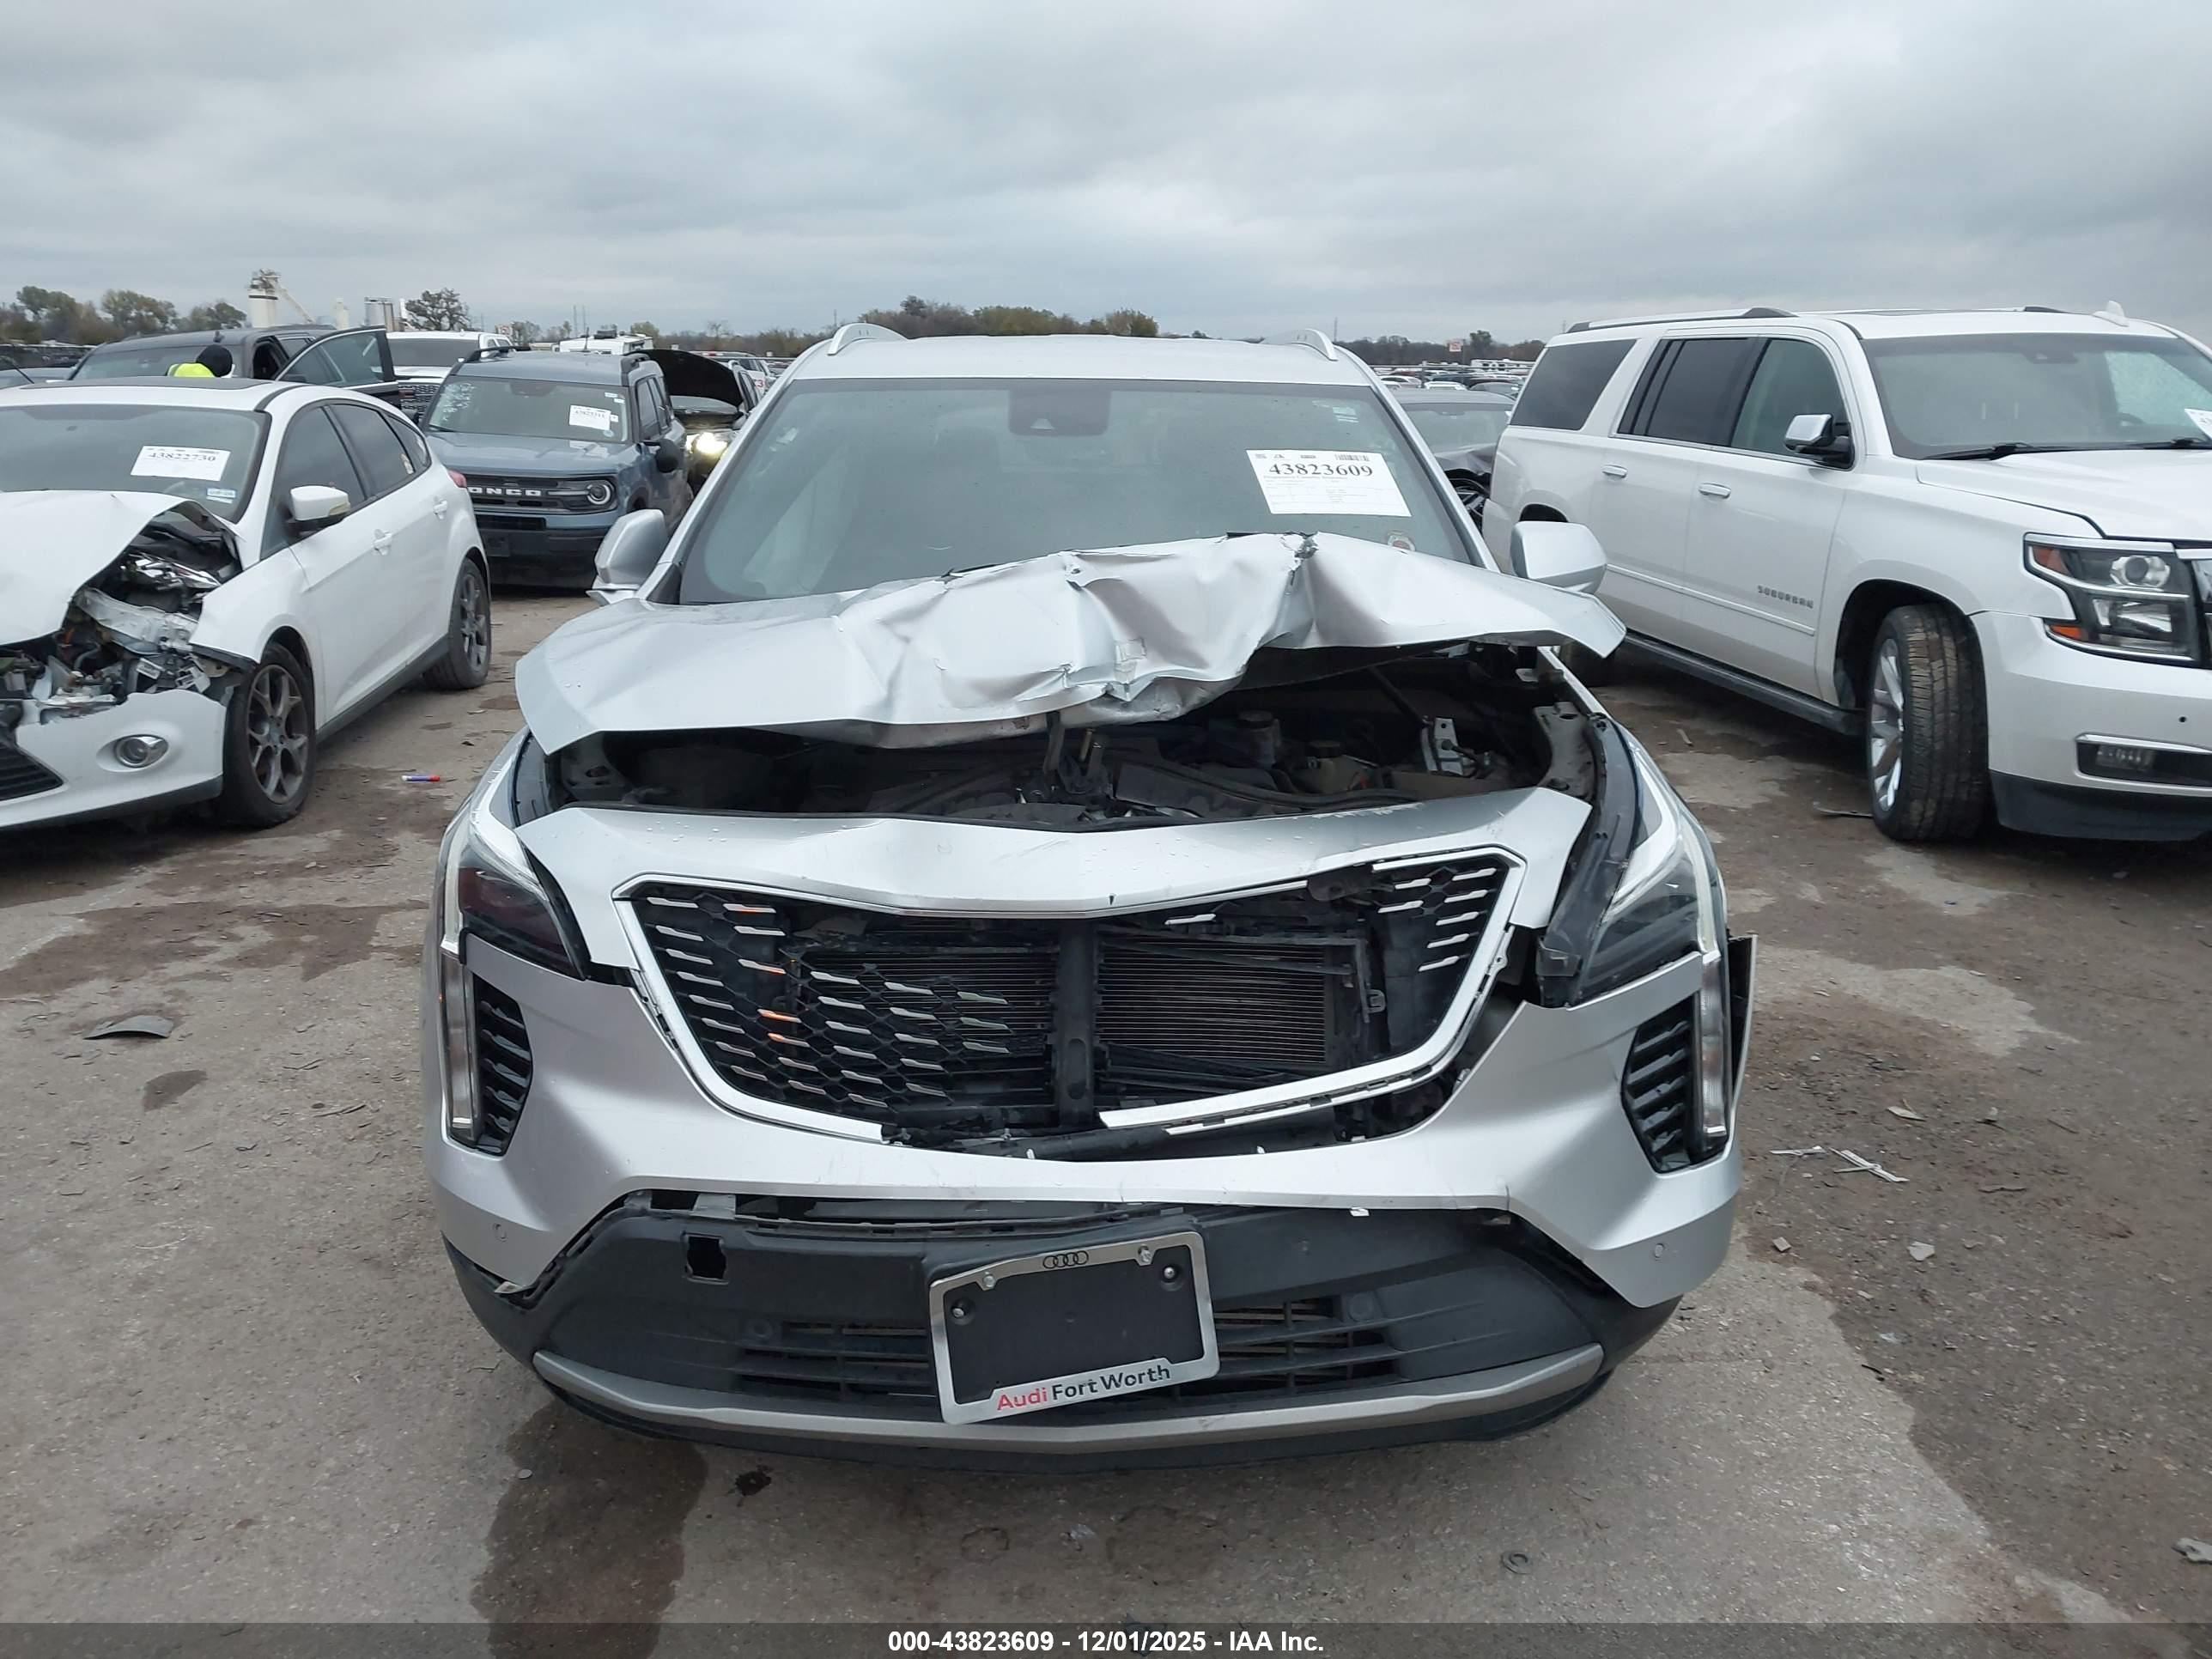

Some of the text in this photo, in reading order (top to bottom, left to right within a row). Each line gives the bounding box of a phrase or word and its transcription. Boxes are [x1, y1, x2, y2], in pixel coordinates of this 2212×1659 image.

[1269, 463, 1373, 477] 43823609
[467, 486, 541, 496] ONCO
[997, 1364, 1170, 1411] Audi Fort Worth
